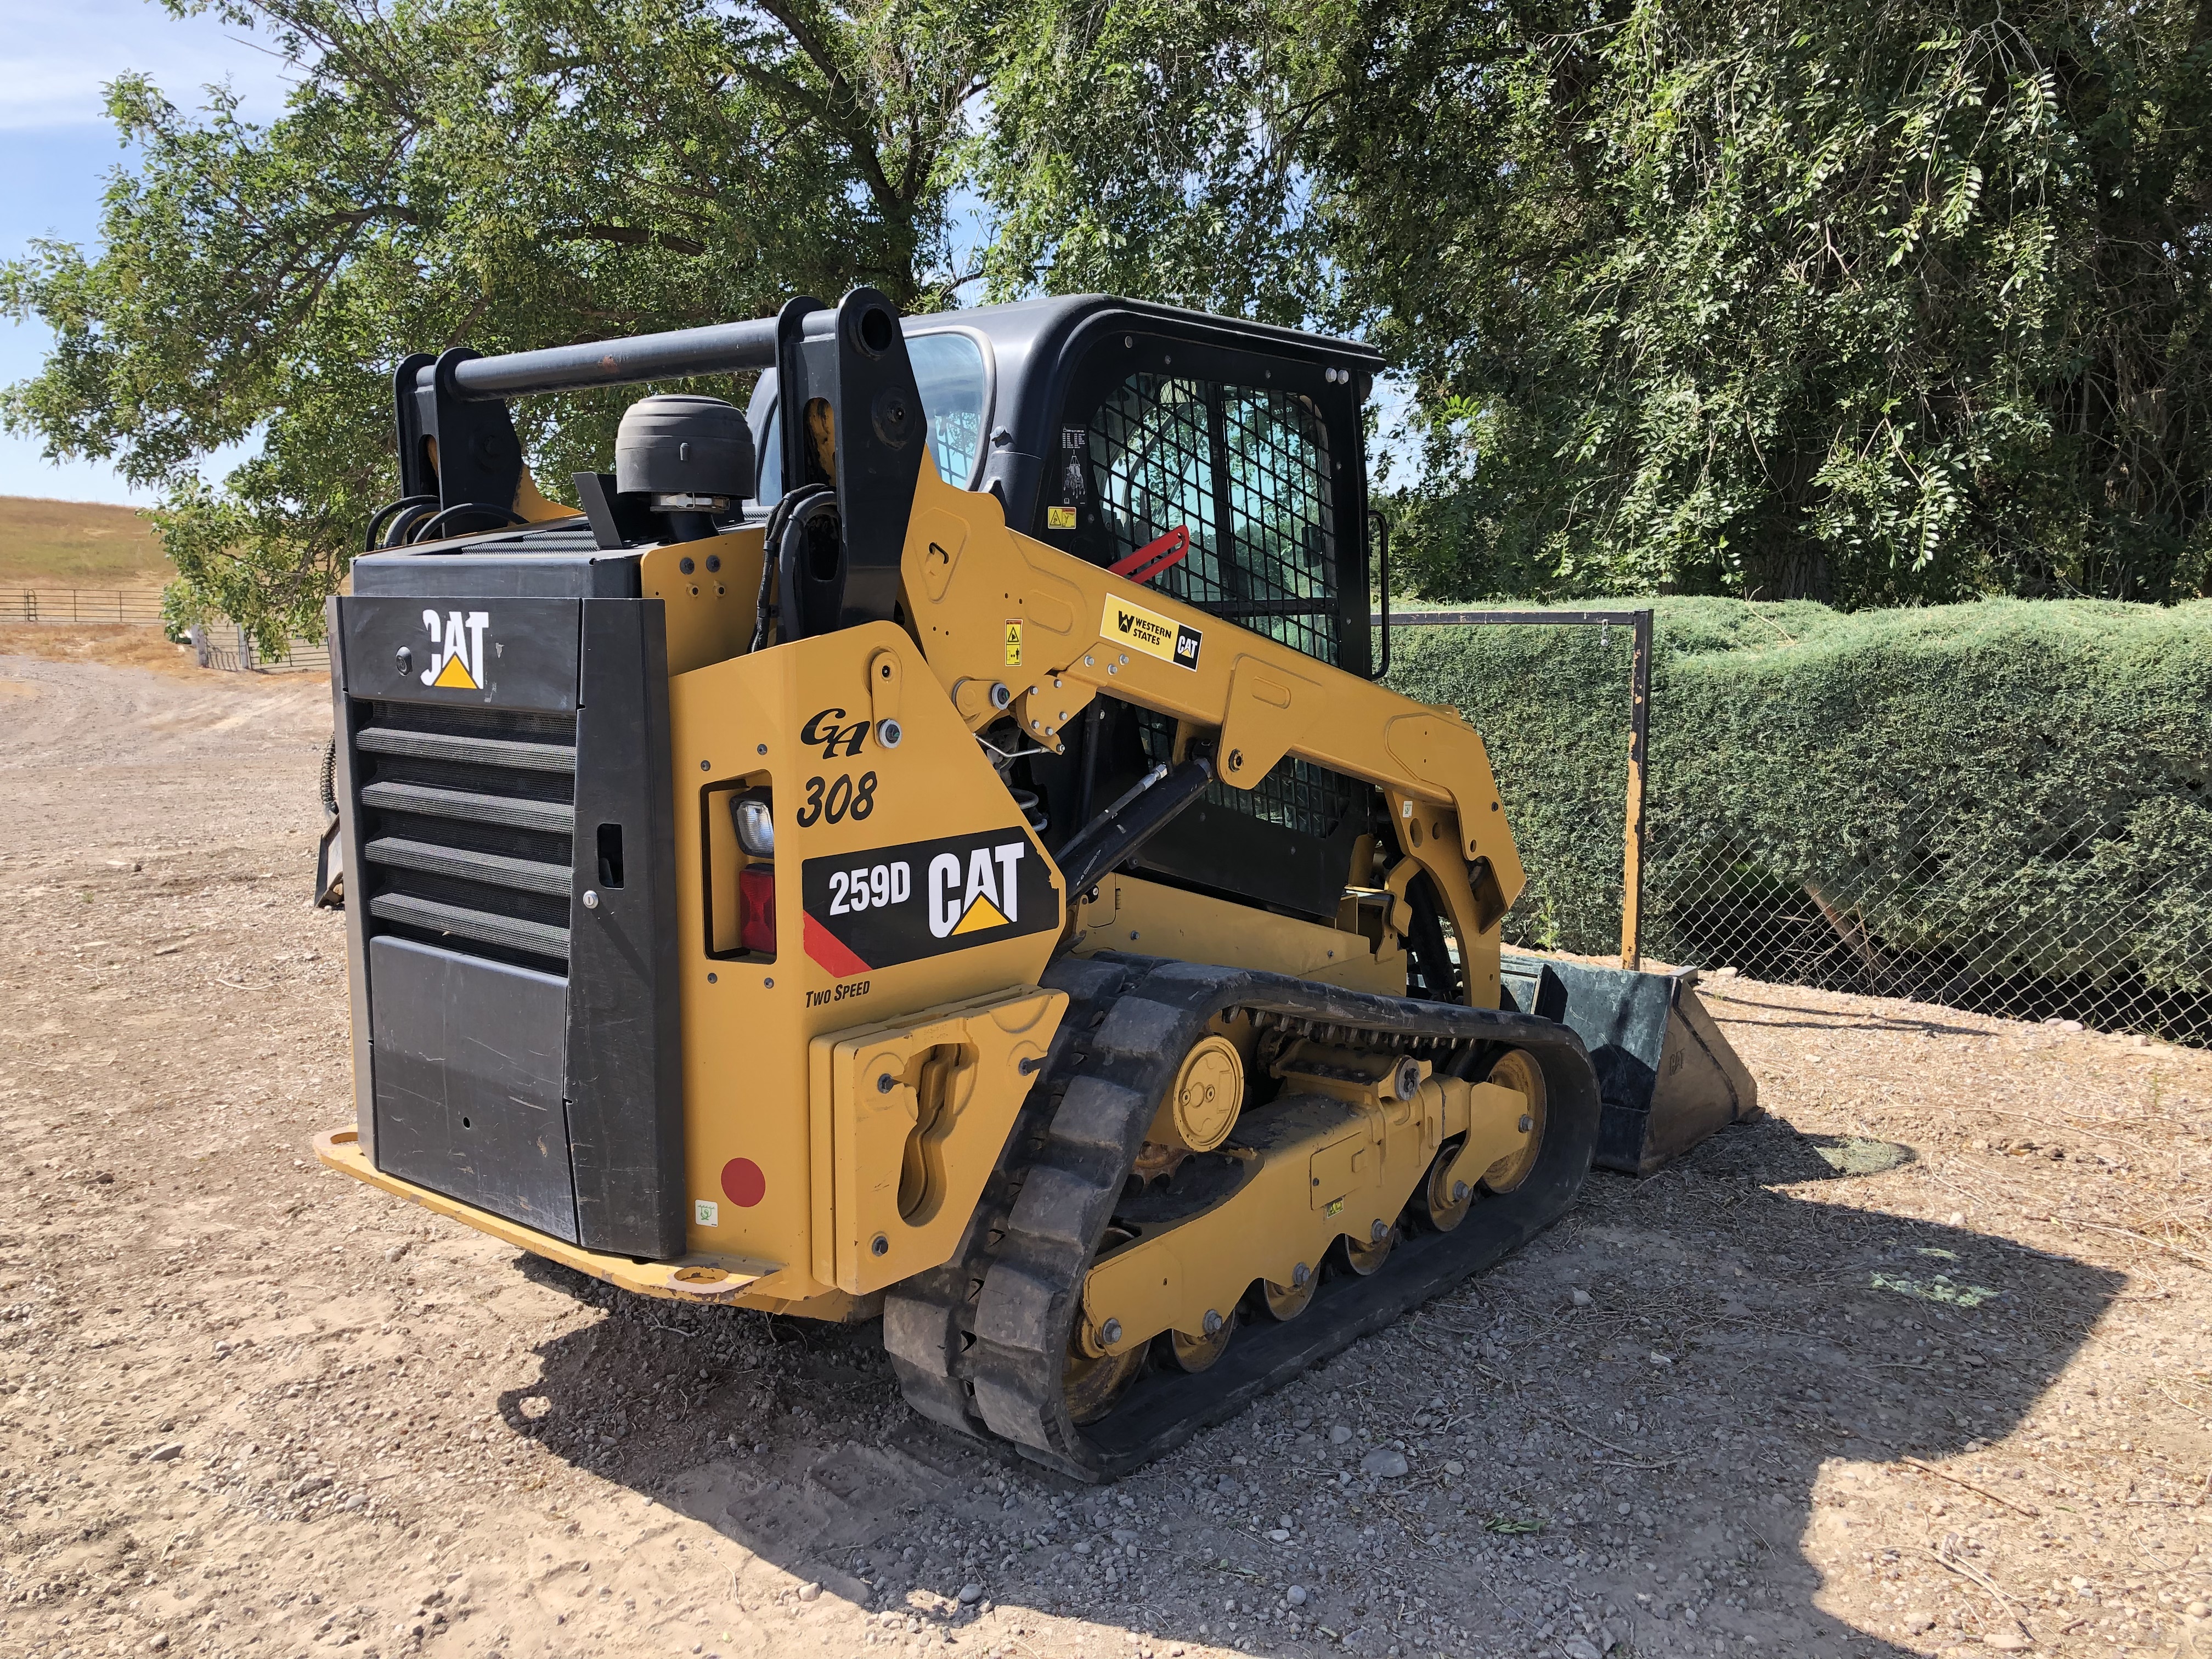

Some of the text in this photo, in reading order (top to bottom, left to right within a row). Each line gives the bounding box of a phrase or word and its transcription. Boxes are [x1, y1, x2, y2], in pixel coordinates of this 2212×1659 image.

[420, 609, 489, 690] CAT
[1133, 628, 1160, 645] STATES
[1136, 617, 1172, 639] WESTERN
[1177, 635, 1198, 659] CAT
[800, 708, 871, 759] GA
[797, 770, 878, 827] 308
[829, 842, 1024, 938] 259D CAT
